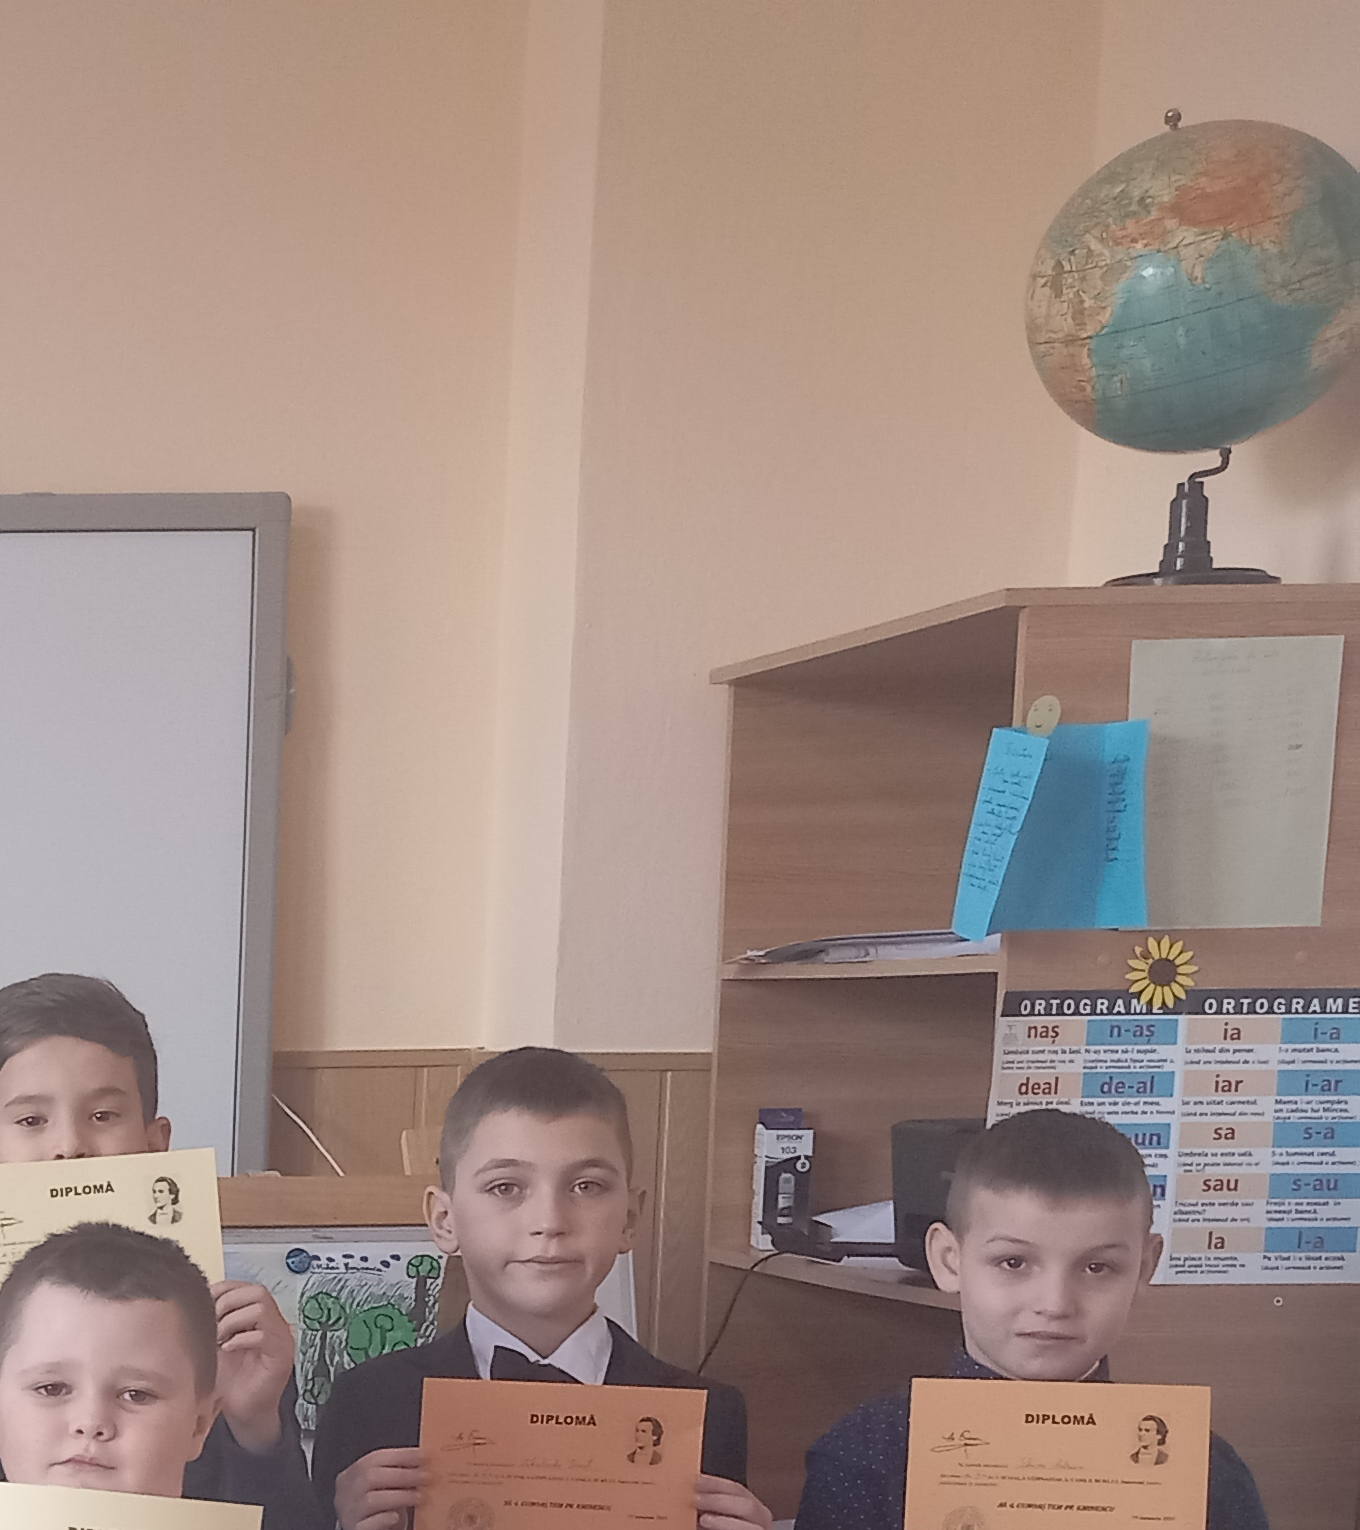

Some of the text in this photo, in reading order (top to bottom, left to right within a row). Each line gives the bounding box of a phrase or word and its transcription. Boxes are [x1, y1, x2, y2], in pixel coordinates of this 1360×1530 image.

[1204, 998, 1360, 1013] ORTOGRAME
[1028, 1024, 1059, 1044] naș
[1110, 1023, 1155, 1044] n-aș
[1223, 1022, 1241, 1040] ia
[1313, 1022, 1340, 1040] i-a
[1018, 1077, 1059, 1096] deal
[1101, 1075, 1154, 1095] de-al
[1215, 1074, 1243, 1092] iar
[1305, 1074, 1342, 1092] i-ar
[1213, 1126, 1235, 1140] sa
[1303, 1126, 1335, 1140] s-a
[49, 1180, 115, 1198] DIPLOMĂ
[1202, 1178, 1239, 1192] sau
[1292, 1178, 1338, 1191] s-au
[1207, 1231, 1225, 1249] la
[1297, 1231, 1324, 1249] l-a
[529, 1413, 597, 1427] DIPLOMĂ
[1024, 1412, 1097, 1427] DIPLOMĂ
